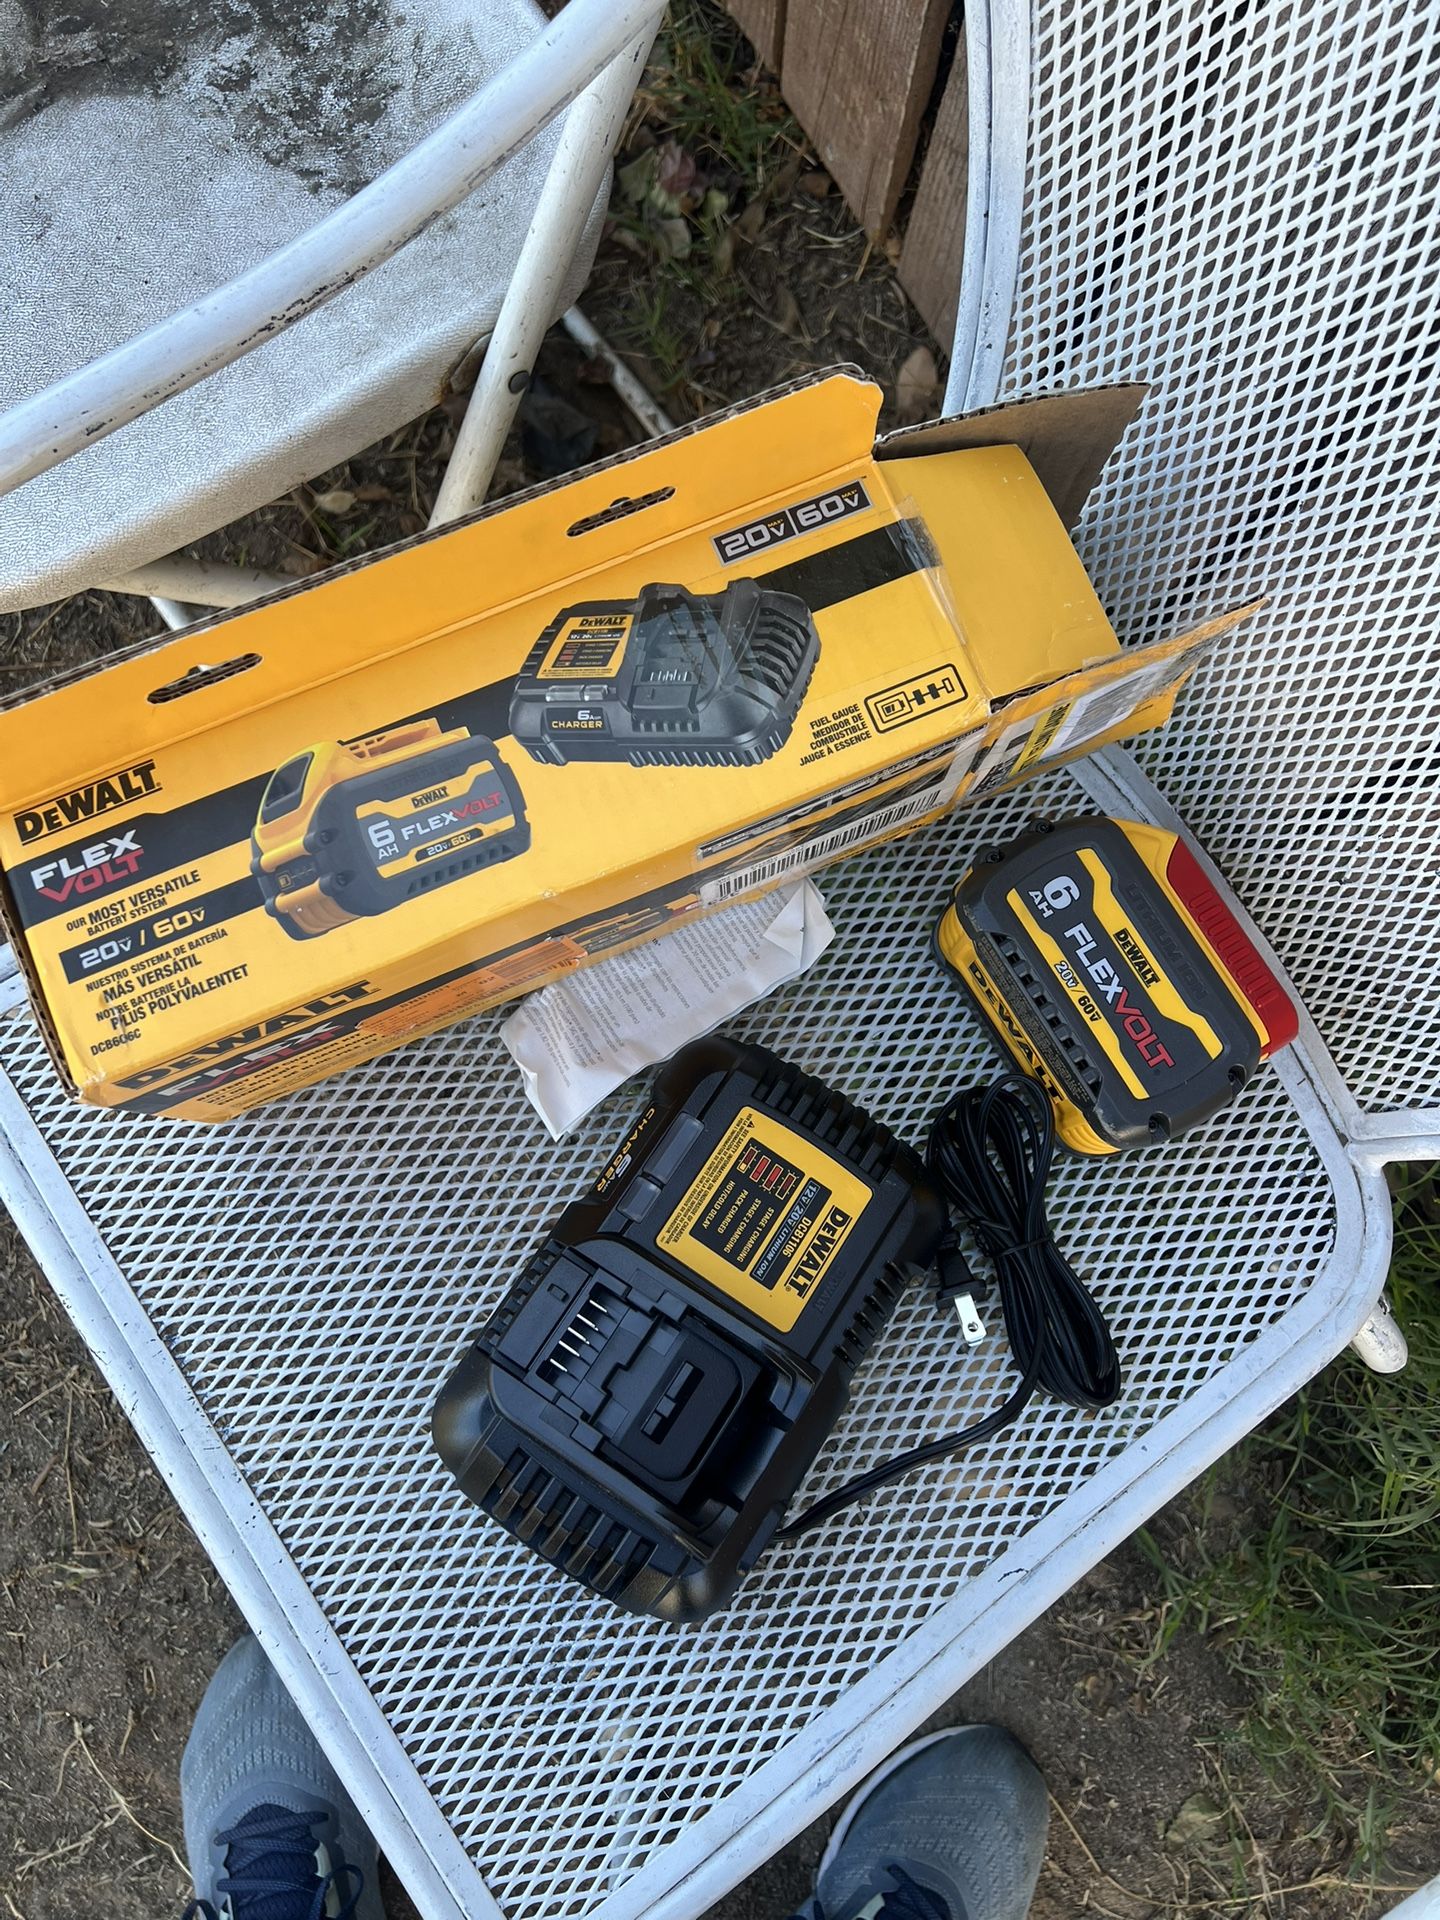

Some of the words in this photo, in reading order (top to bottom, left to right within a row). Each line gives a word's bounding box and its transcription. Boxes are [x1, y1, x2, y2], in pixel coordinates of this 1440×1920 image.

[552, 720, 603, 729] CHARGER
[809, 715, 831, 729] FUEL
[831, 703, 860, 720] GAUGE
[811, 718, 850, 739] MEDIDOR
[851, 712, 864, 723] DE
[797, 748, 826, 766] JAUGE
[824, 743, 833, 755] À
[833, 730, 872, 751] ESSENCE
[809, 721, 868, 750] COMBUSTIBLE
[14, 761, 157, 843] DEWALT
[367, 820, 395, 849] 6
[376, 842, 399, 859] AH
[30, 829, 142, 890] FLEX
[38, 848, 145, 903] VOLT
[65, 916, 87, 932] OUR
[87, 899, 128, 925] MOST
[127, 869, 202, 908] VERSATILE
[1027, 886, 1053, 918] AH
[1043, 875, 1081, 910] 6
[86, 912, 129, 936] BATTERY
[128, 897, 168, 919] SYSTEM
[84, 967, 130, 993] NUESTRO
[129, 950, 172, 974] SISTEMA
[172, 944, 187, 957] DE
[186, 925, 228, 951] BATERÍA
[1114, 927, 1159, 988] DEWALT
[100, 976, 136, 1003] MÁS
[135, 949, 203, 988] VERSÁTIL
[95, 1001, 130, 1022] NOTRE
[129, 982, 176, 1007] BATTERIE
[176, 975, 191, 988] LA
[109, 1005, 147, 1031] PLUS
[146, 963, 251, 1015] POLYVALENTET
[89, 1027, 142, 1056] DCB606C
[114, 980, 374, 1090] DEWALT
[967, 960, 1064, 1106] DEWALT
[158, 1021, 340, 1096] FLEX
[594, 1105, 655, 1193] CHARGER
[712, 1179, 735, 1210] HOT/COLD
[734, 1188, 749, 1206] PACK
[745, 1197, 761, 1218] STAGE
[700, 1208, 717, 1229] DELAY
[716, 1204, 738, 1234] CHARGED
[757, 1206, 774, 1227] STAGE
[722, 1220, 746, 1253] CHARGING
[735, 1229, 759, 1263] CHARGING
[780, 1215, 812, 1259] DCB1106
[786, 1206, 851, 1298] DEWALT
[755, 1259, 770, 1277] ION
